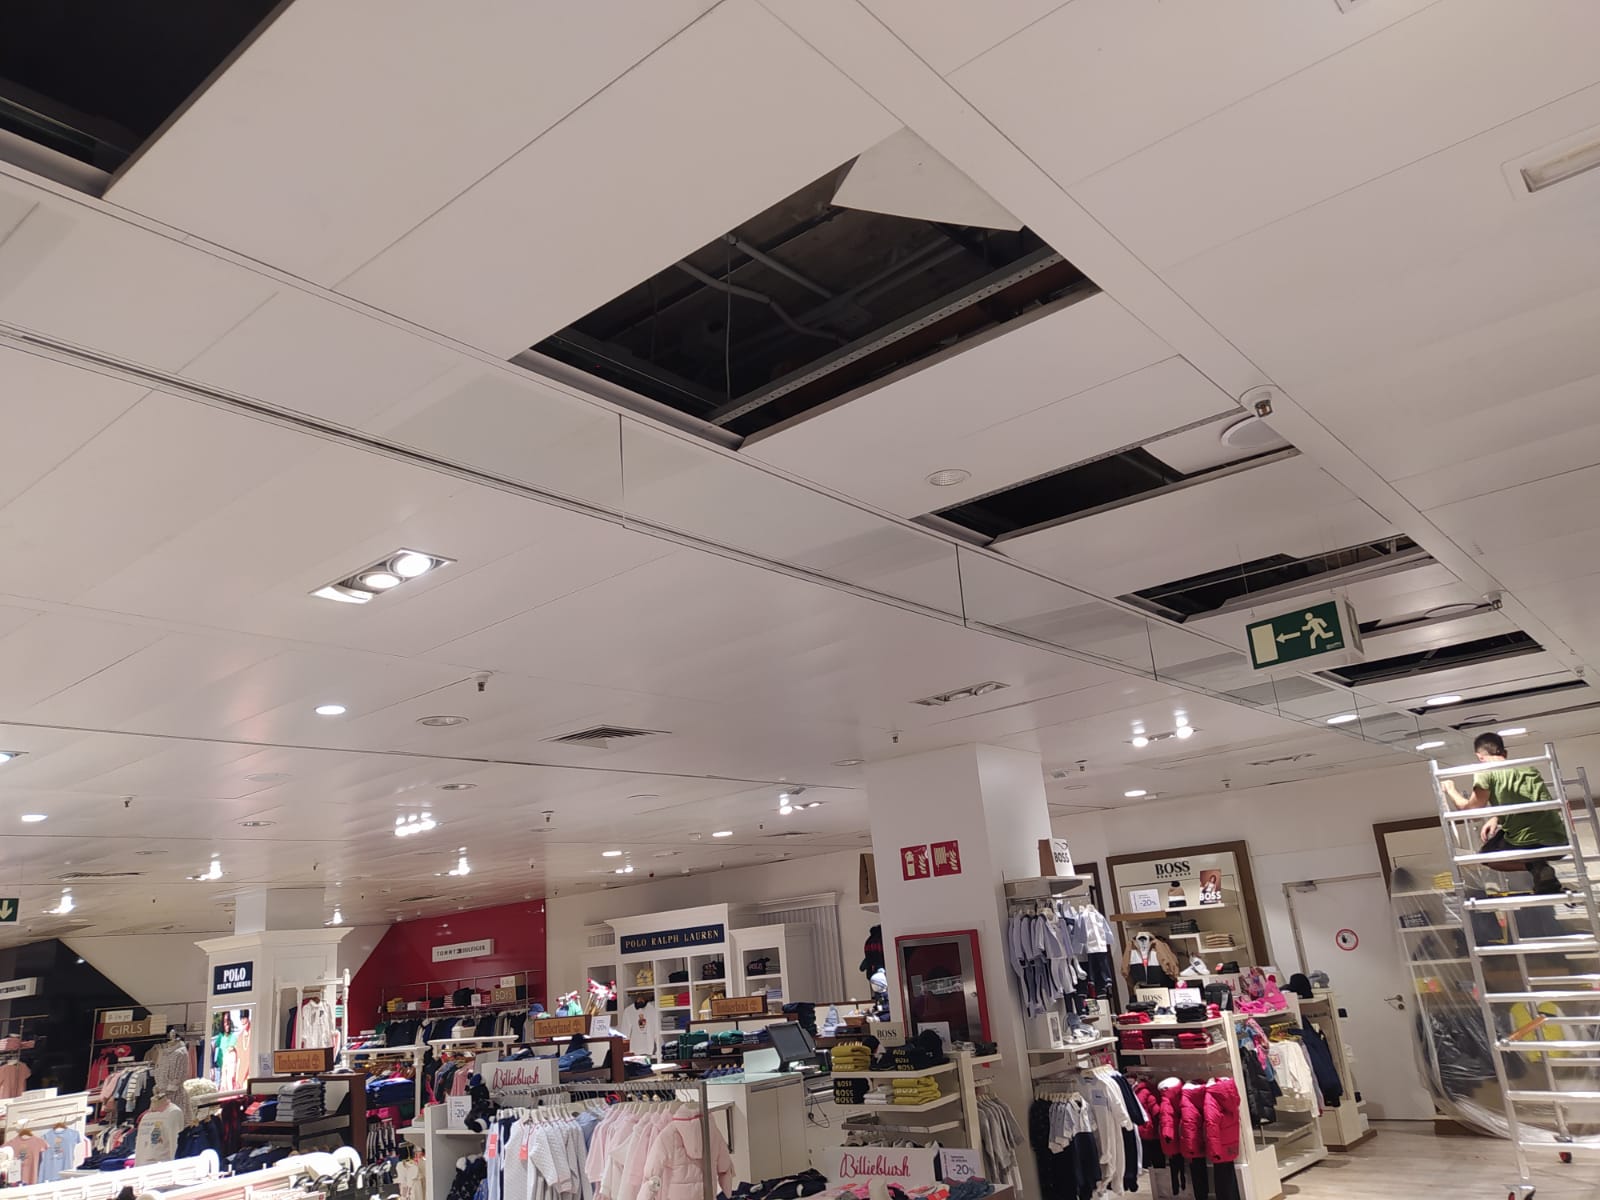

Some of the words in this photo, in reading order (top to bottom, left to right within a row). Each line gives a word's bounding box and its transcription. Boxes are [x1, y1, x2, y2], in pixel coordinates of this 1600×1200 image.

[1053, 851, 1070, 863] BOSS
[1154, 860, 1191, 876] BOSS
[1199, 890, 1222, 901] BOSS
[1140, 898, 1157, 908] -20%
[625, 938, 648, 949] POLO
[651, 934, 680, 946] RALPH
[684, 929, 720, 943] LAUREN
[222, 967, 247, 983] POLO
[1142, 993, 1164, 1001] BOSS
[110, 1023, 143, 1037] GIRLS
[876, 1029, 897, 1038] BOSS
[493, 1066, 540, 1089] Billieblush
[840, 1152, 911, 1178] Billieblush
[952, 1163, 976, 1176] -20%
